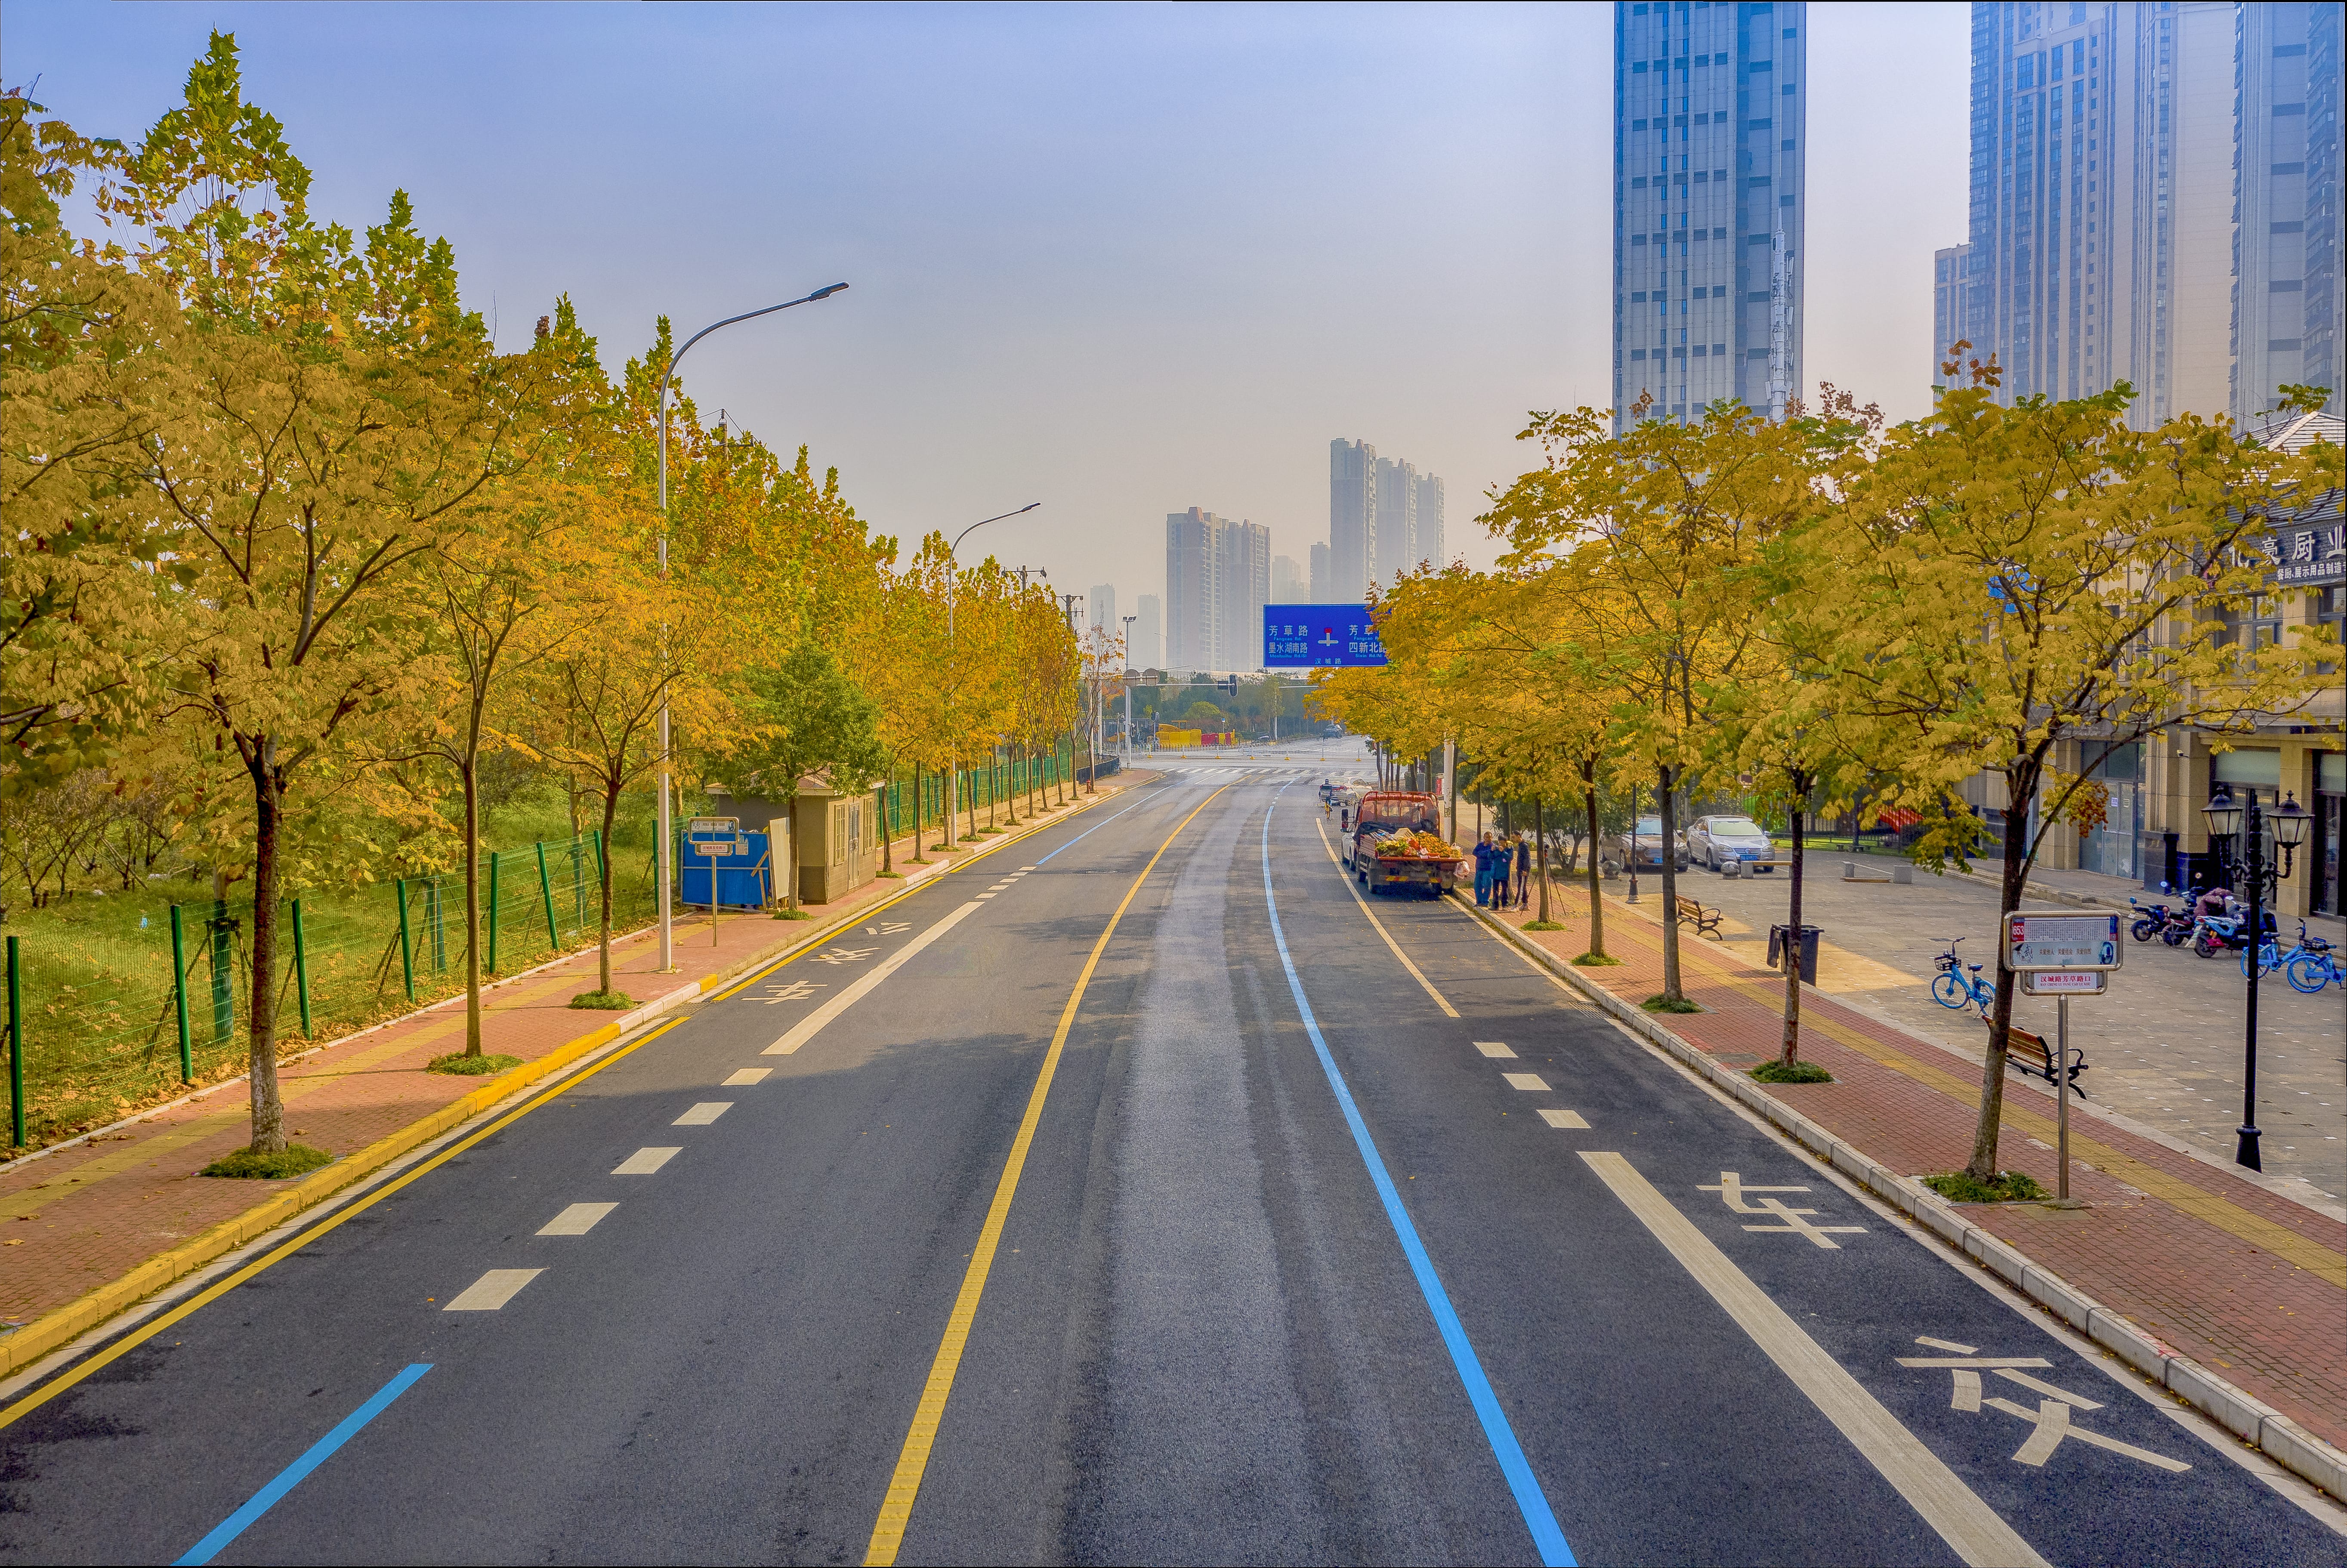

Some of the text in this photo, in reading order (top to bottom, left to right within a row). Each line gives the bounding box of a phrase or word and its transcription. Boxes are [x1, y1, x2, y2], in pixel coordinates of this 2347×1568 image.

[1269, 625, 1308, 636] 芳草路
[1349, 625, 1374, 636] 芳草
[1269, 642, 1308, 653] 墨水湖南路
[2013, 926, 2024, 935] 653
